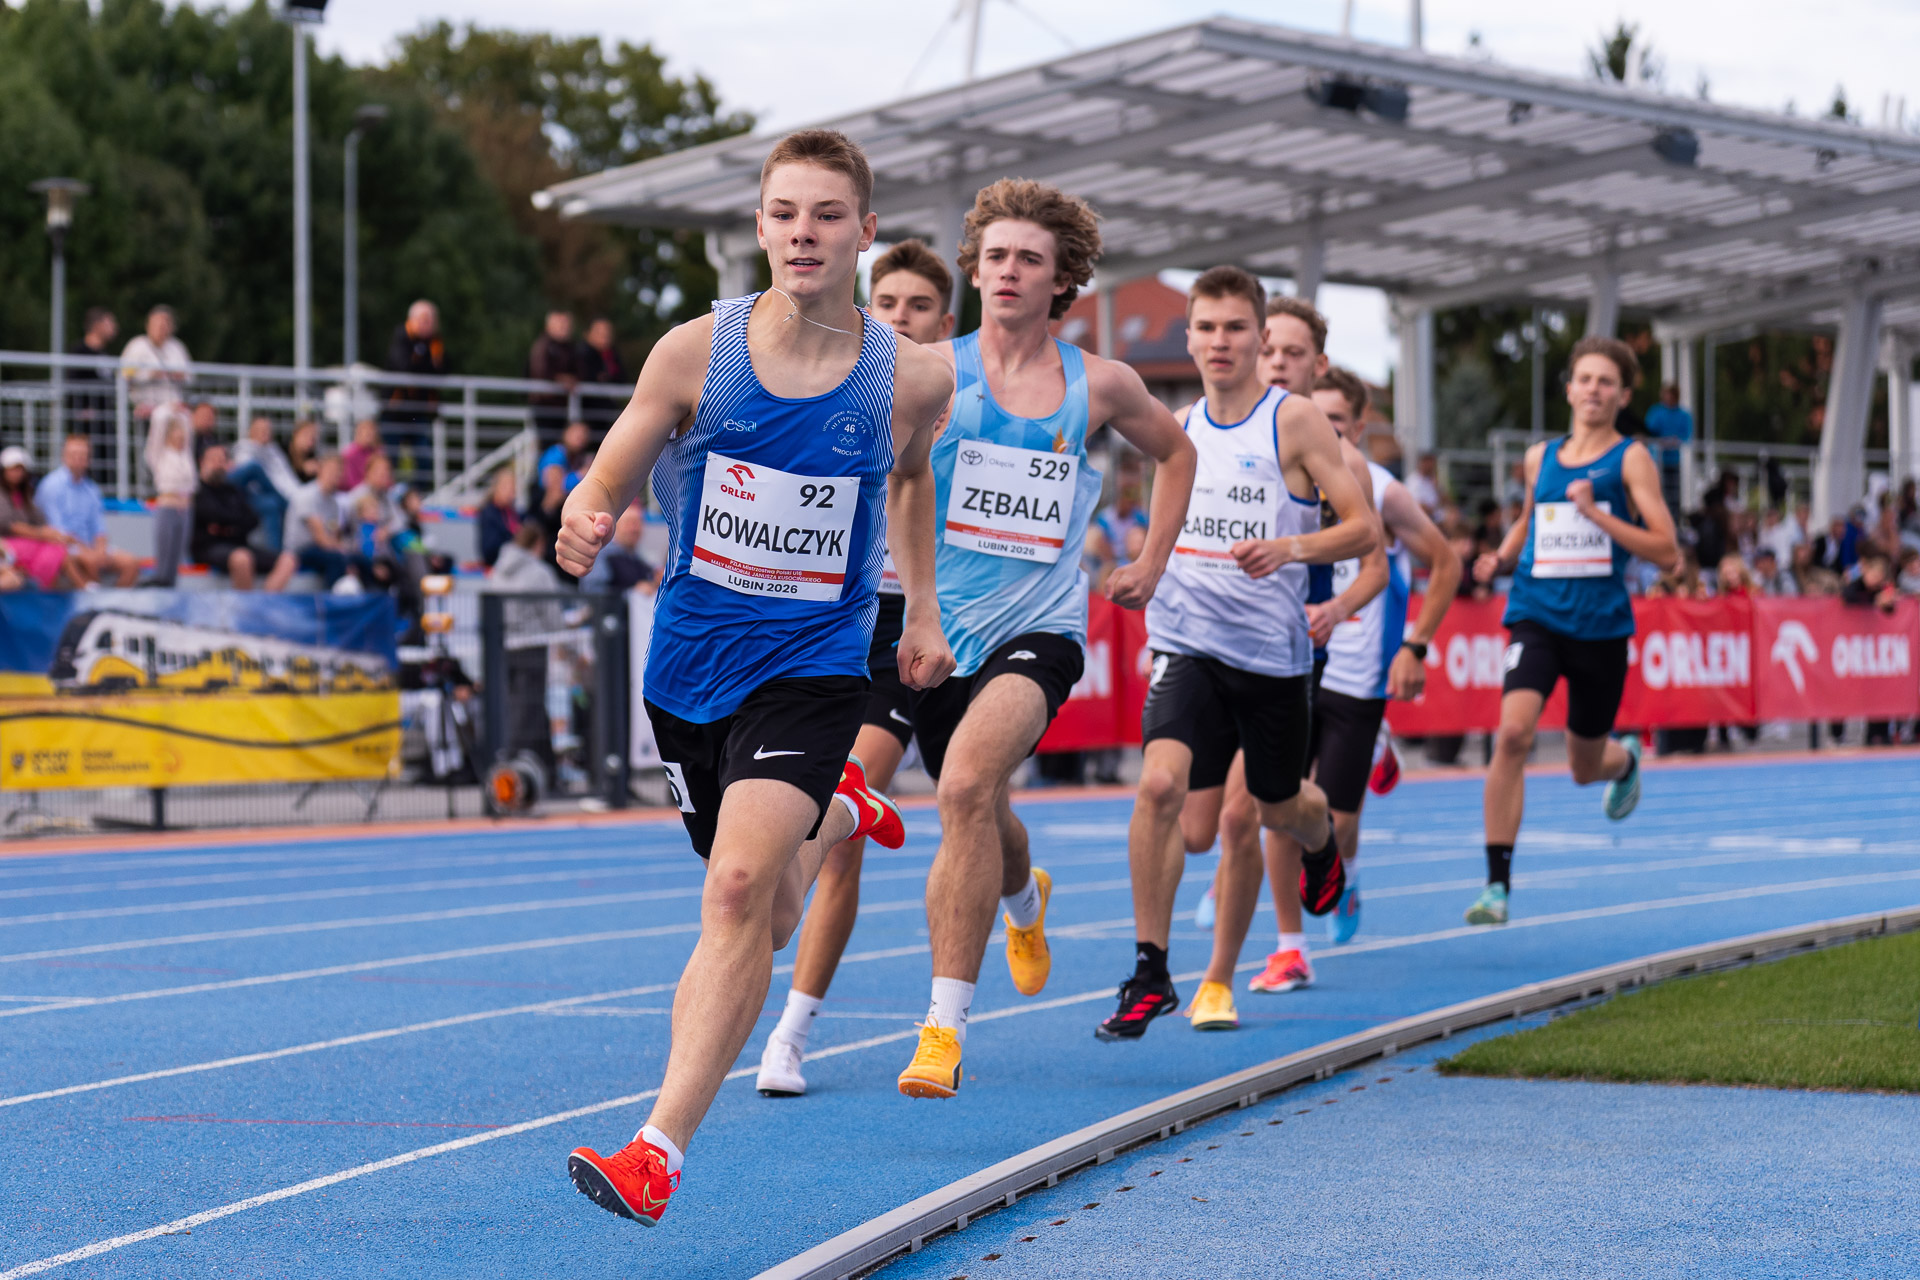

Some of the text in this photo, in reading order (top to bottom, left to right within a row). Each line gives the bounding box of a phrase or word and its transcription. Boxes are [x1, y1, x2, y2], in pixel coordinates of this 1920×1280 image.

[844, 424, 856, 433] 46
[1028, 458, 1070, 482] 529
[720, 484, 755, 502] ORLEN
[799, 484, 836, 508] 92
[1227, 486, 1266, 504] 484
[962, 486, 1061, 524] ZĘBALA
[702, 504, 846, 557] KOWALCZYK
[978, 540, 1035, 556] LUBIN 2026
[727, 574, 799, 594] LUBIN 2026
[752, 572, 778, 580] JANUSZA
[1641, 631, 1750, 689] ORLEN
[1830, 634, 1910, 677] ORLEN
